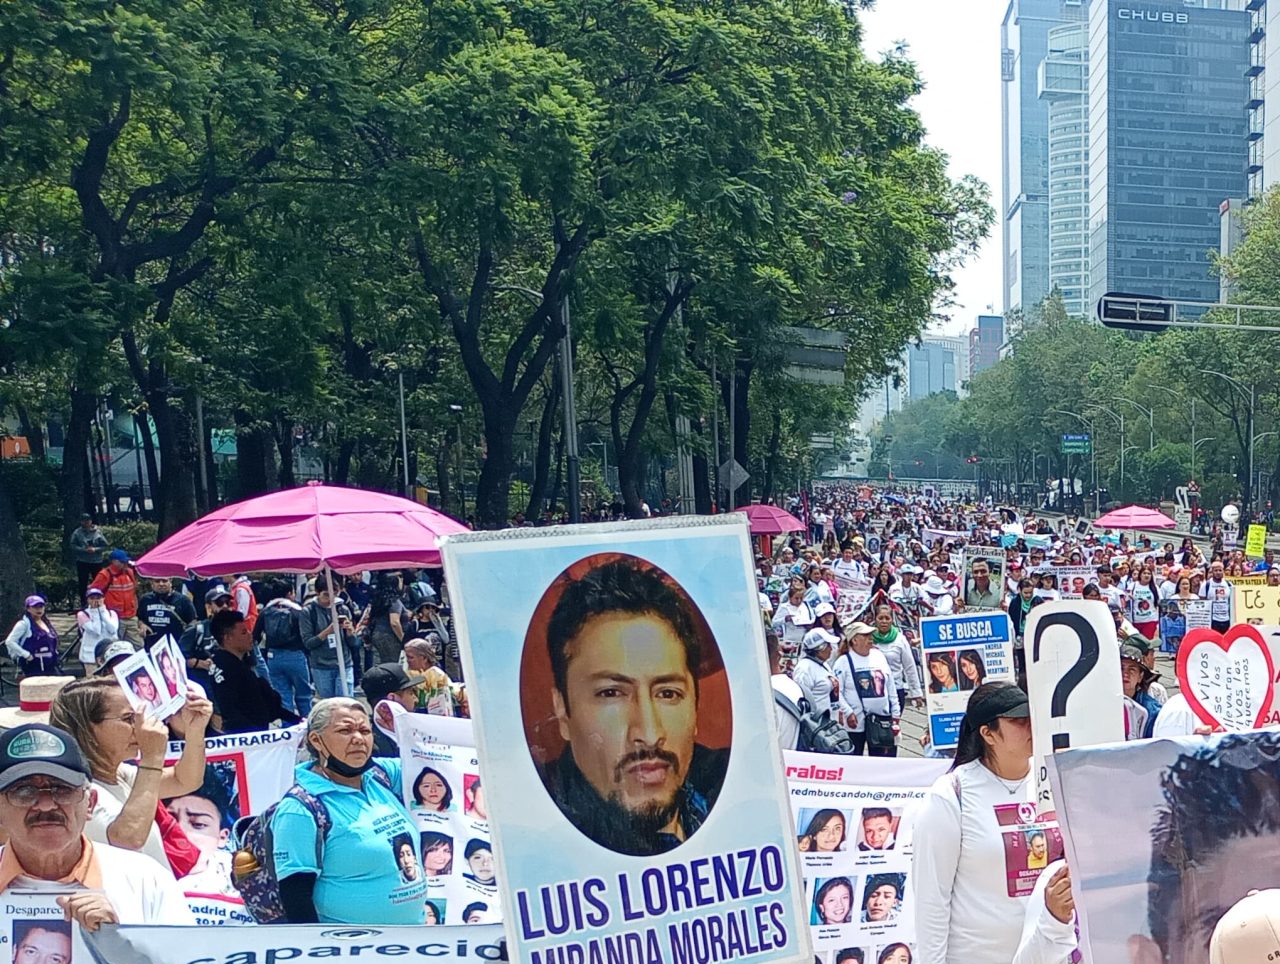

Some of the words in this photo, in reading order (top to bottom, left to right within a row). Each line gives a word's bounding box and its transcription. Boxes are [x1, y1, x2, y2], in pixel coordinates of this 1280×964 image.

[1118, 8, 1189, 24] CHUBB
[1241, 590, 1265, 609] TE
[939, 623, 954, 640] SE
[957, 620, 993, 638] BUSCA
[517, 879, 610, 940] LUIS
[618, 845, 784, 921] LORENZO
